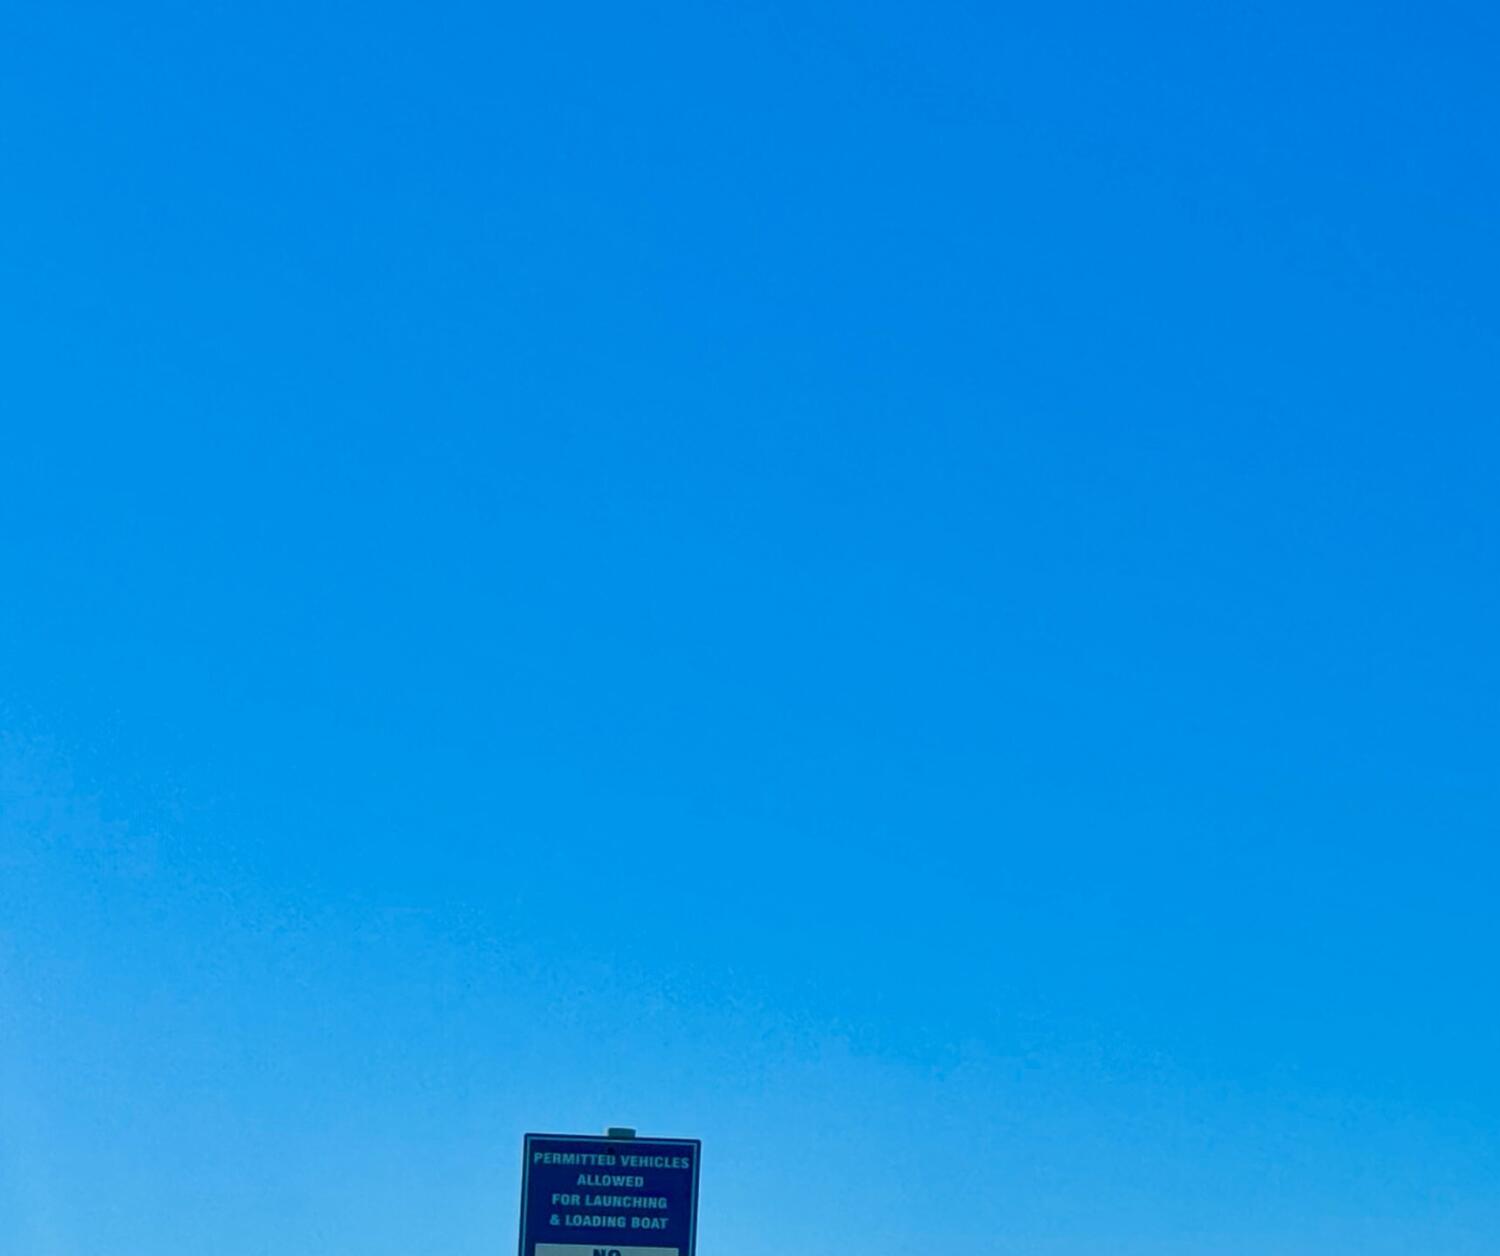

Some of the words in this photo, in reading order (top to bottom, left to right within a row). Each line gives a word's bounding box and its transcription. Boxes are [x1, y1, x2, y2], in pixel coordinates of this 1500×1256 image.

[533, 1152, 616, 1166] PERMITTED
[620, 1155, 690, 1169] VEHICLES
[576, 1174, 644, 1187] ALLOWED
[552, 1193, 580, 1206] FOR
[585, 1194, 667, 1209] LAUNCHING
[550, 1214, 560, 1226] &
[565, 1214, 626, 1228] LOADING
[631, 1217, 669, 1230] BOAT
